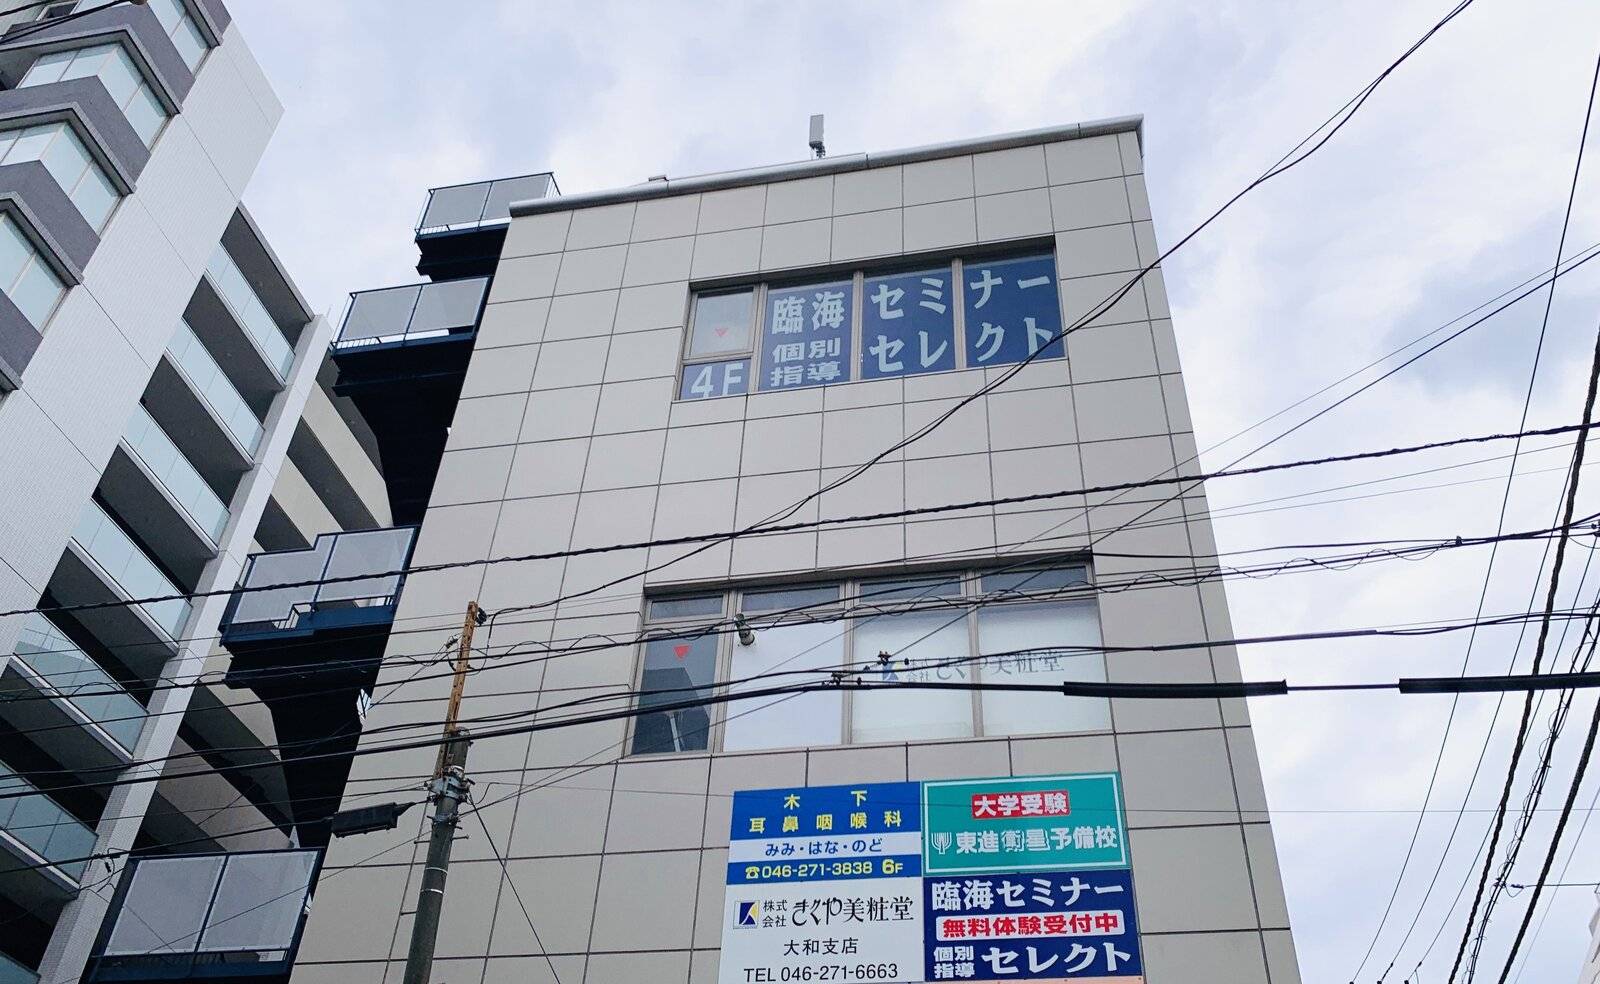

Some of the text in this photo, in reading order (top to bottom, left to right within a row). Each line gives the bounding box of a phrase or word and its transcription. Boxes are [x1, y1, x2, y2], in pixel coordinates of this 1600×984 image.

[771, 269, 1050, 335] 臨海セミナー
[773, 337, 841, 363] 個別
[869, 317, 1053, 373] セレクト
[690, 362, 744, 399] 4F
[770, 361, 841, 387] 指導
[974, 791, 1068, 818] 大学受験
[748, 810, 902, 834] 耳鼻咽喉科
[955, 825, 1119, 855] 東進衛星予備校
[761, 858, 904, 879] 046-271-3838 6F
[763, 899, 788, 912] 株式
[931, 876, 1124, 911] 臨海セミナー
[762, 915, 787, 928] 会社
[791, 895, 915, 927] きくや美粧堂
[943, 912, 1119, 938] 無料体験受付中
[783, 937, 859, 957] 大和支店
[933, 945, 975, 962] 個別
[981, 942, 1131, 974] セレクト
[744, 963, 898, 983] TEL 046-271-6663
[933, 962, 975, 979] 指導
